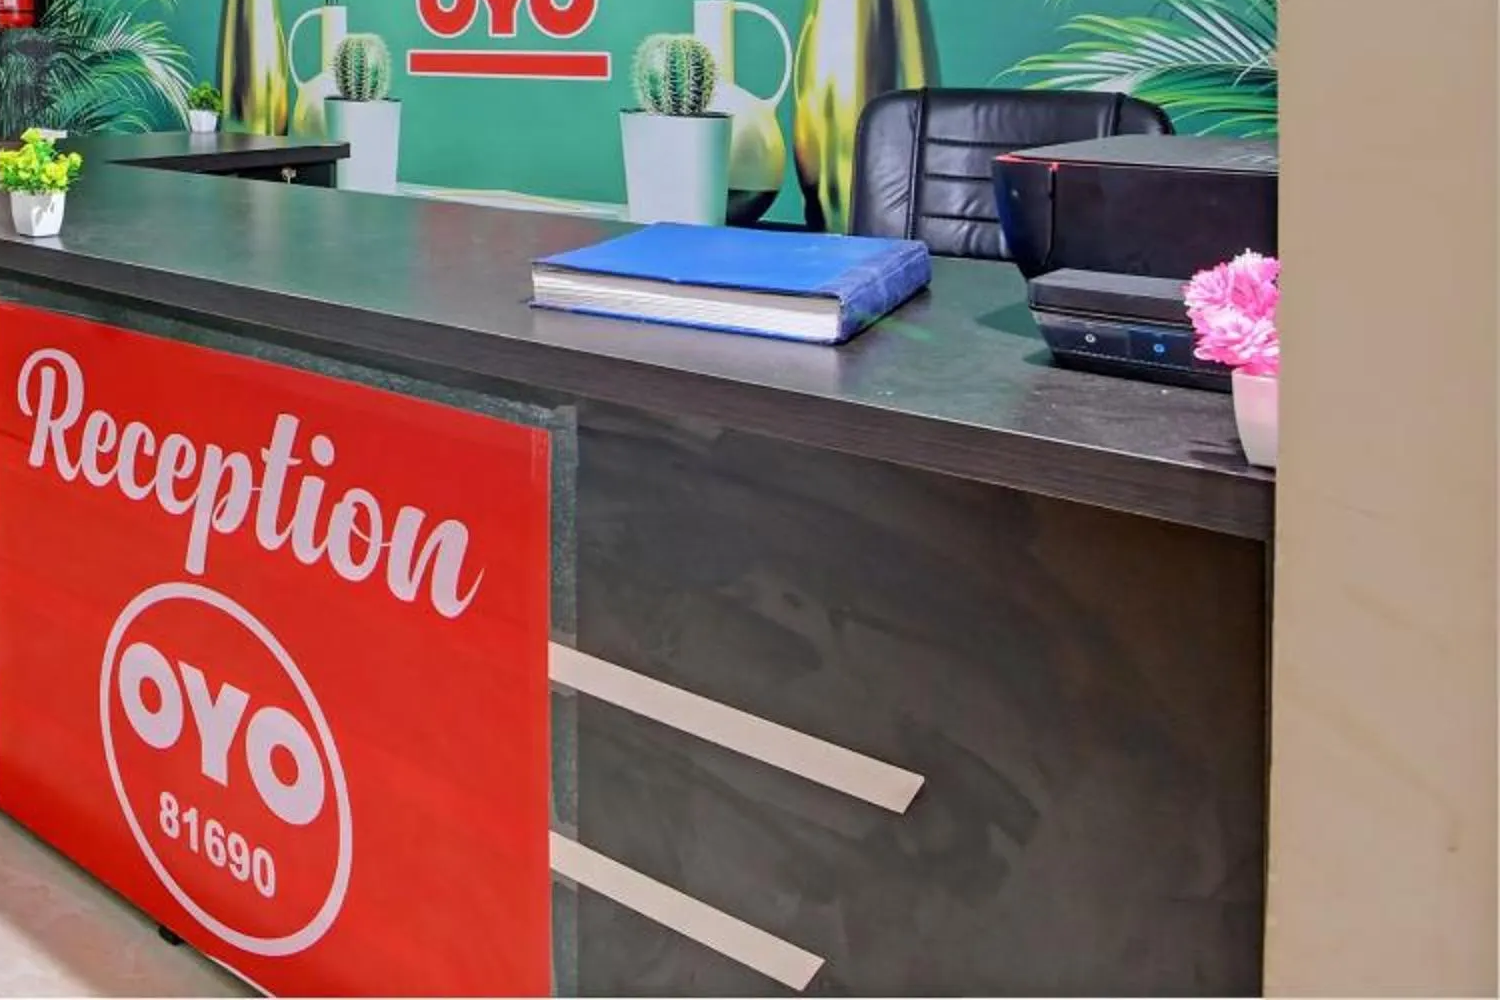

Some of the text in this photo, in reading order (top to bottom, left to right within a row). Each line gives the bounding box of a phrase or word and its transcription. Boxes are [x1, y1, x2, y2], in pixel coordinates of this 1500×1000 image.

[17, 348, 485, 619] Reception
[118, 642, 325, 825] OYO
[159, 791, 277, 897] 81690
